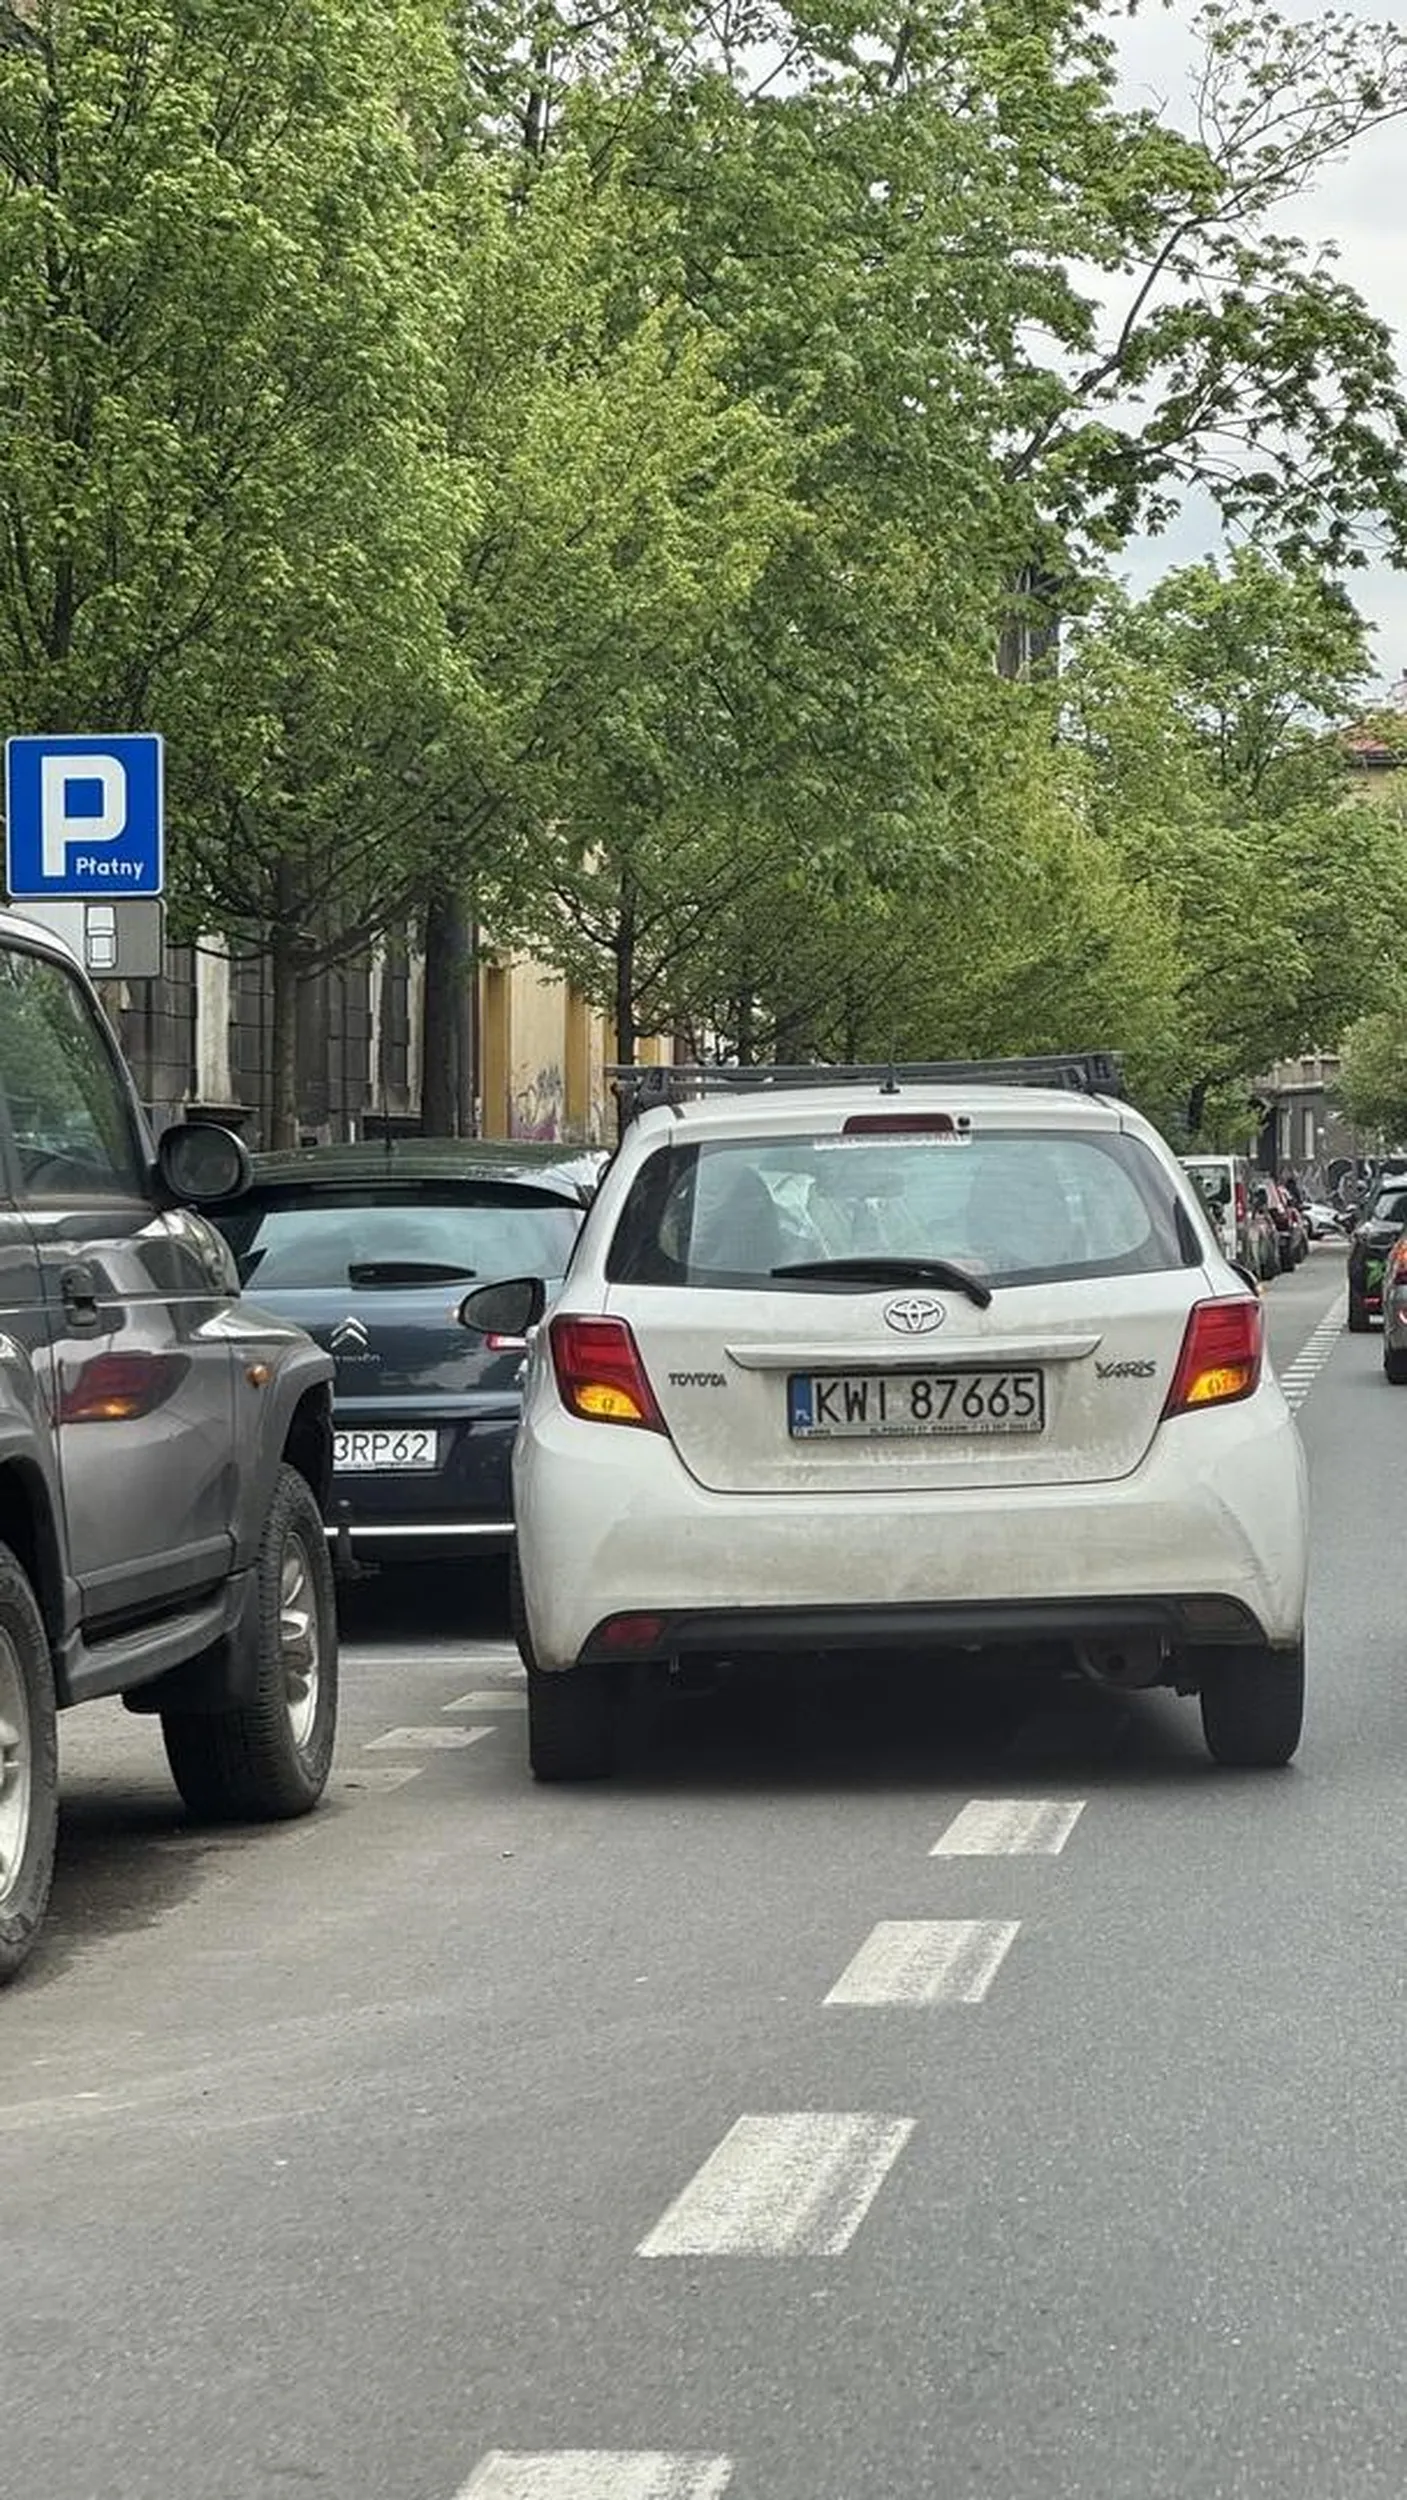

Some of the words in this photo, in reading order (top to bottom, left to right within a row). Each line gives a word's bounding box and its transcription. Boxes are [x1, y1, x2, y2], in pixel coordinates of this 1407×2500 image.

[41, 754, 127, 878] P
[75, 856, 145, 881] Płatny
[667, 1372, 728, 1388] TOYOTA
[1094, 1360, 1157, 1379] YARIS
[815, 1380, 887, 1424] KWI
[910, 1377, 1036, 1420] 87665
